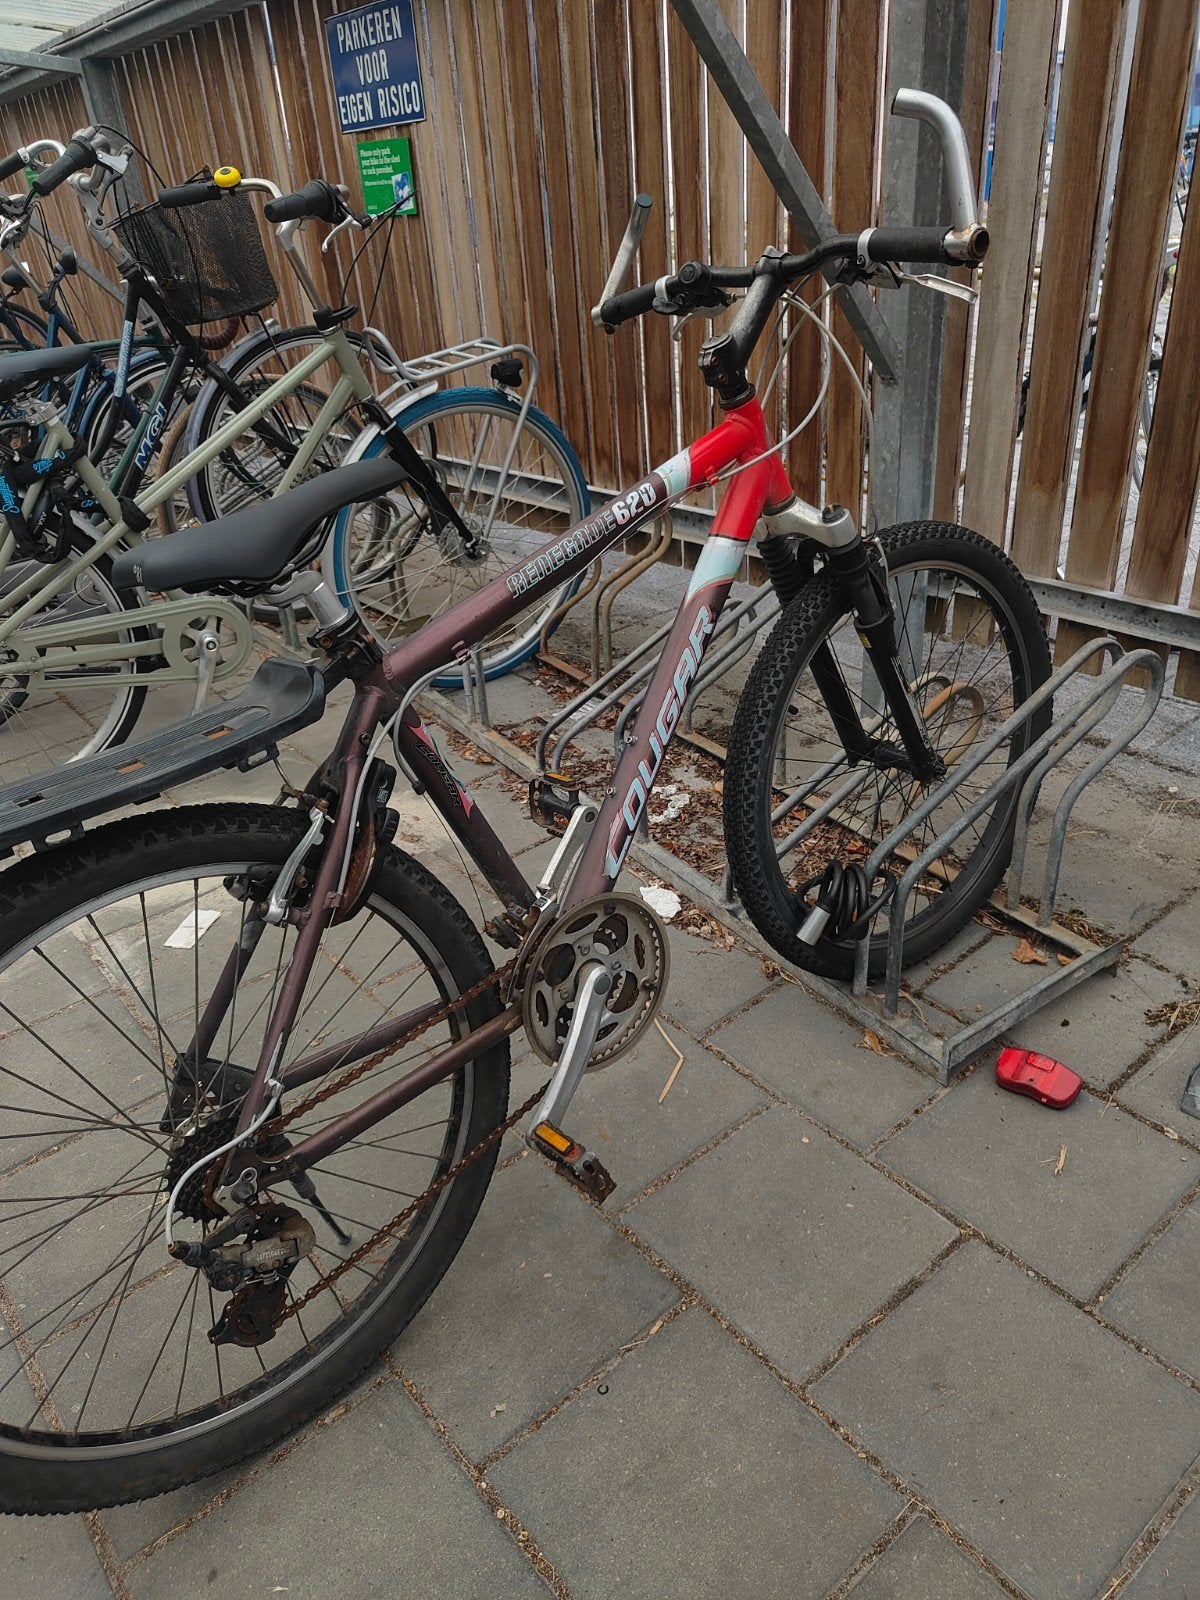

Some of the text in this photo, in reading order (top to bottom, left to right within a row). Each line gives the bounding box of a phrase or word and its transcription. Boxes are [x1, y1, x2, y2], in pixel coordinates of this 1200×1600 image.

[337, 6, 402, 53] PARKEREN
[356, 49, 389, 85] VOOR
[339, 81, 420, 125] EIGEN RISICO
[603, 605, 713, 879] COUGAR
[414, 743, 462, 807] COUGAR
